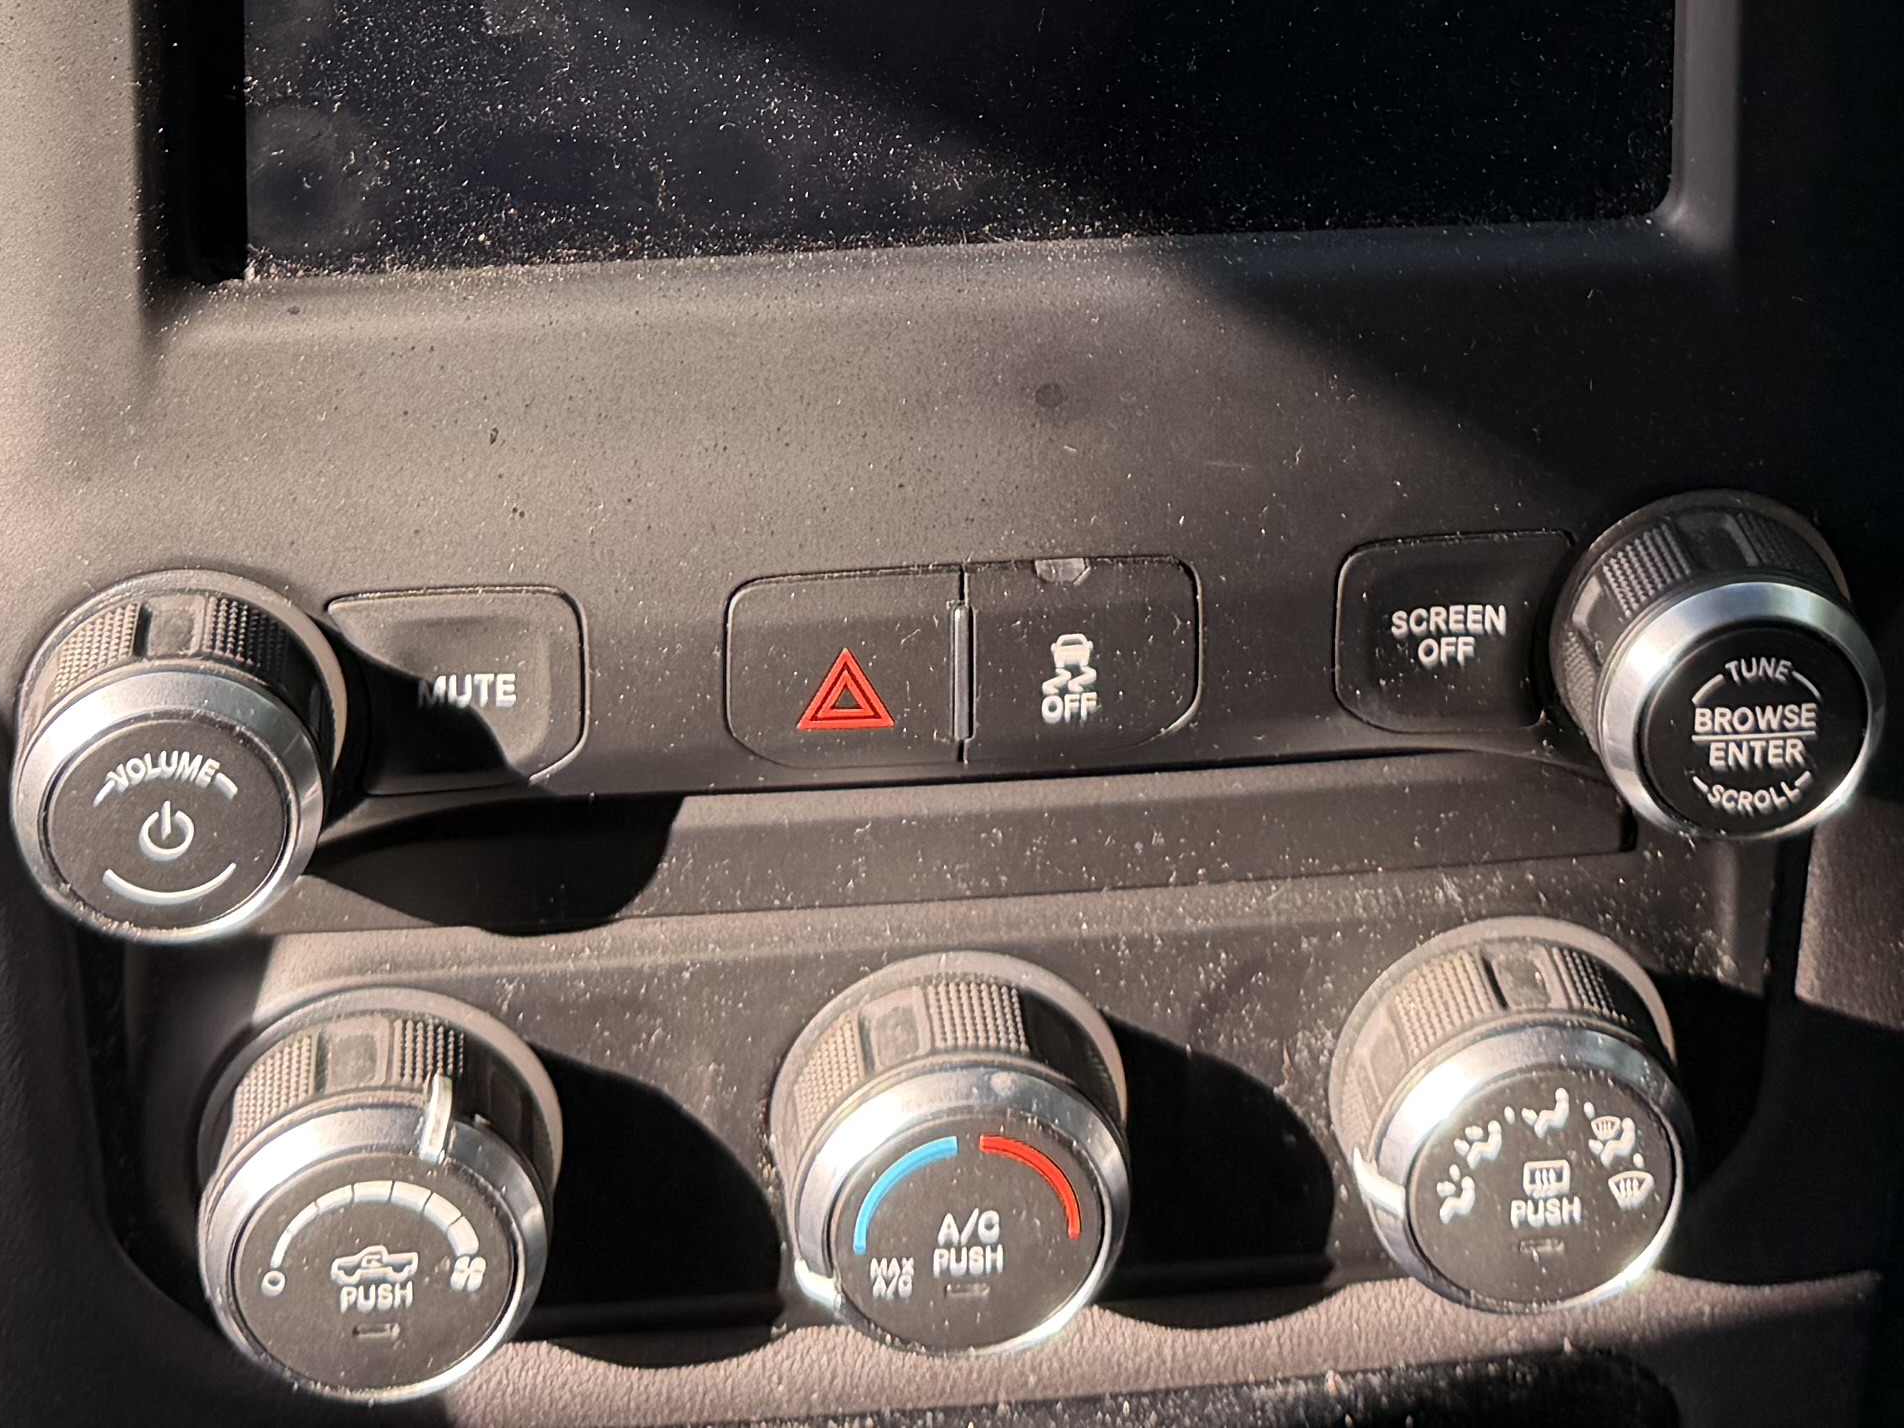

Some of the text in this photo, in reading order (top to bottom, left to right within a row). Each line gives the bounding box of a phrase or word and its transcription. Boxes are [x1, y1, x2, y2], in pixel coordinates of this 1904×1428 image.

[1391, 604, 1507, 637] SCREEN
[1418, 635, 1476, 669] OFF
[1725, 656, 1793, 685] TUNE
[418, 672, 517, 709] MUTE
[1041, 693, 1098, 724] OFF
[1694, 703, 1818, 733] BROWSE
[105, 750, 221, 793] VOLUME
[1709, 739, 1807, 771] ENTER
[1707, 781, 1802, 817] SCROLL
[937, 1208, 1001, 1246] A/C
[1510, 1196, 1582, 1229] PUSH
[870, 1257, 915, 1282] MAX
[933, 1244, 1004, 1278] PUSH
[340, 1280, 413, 1313] PUSH
[872, 1274, 913, 1300] A/C
